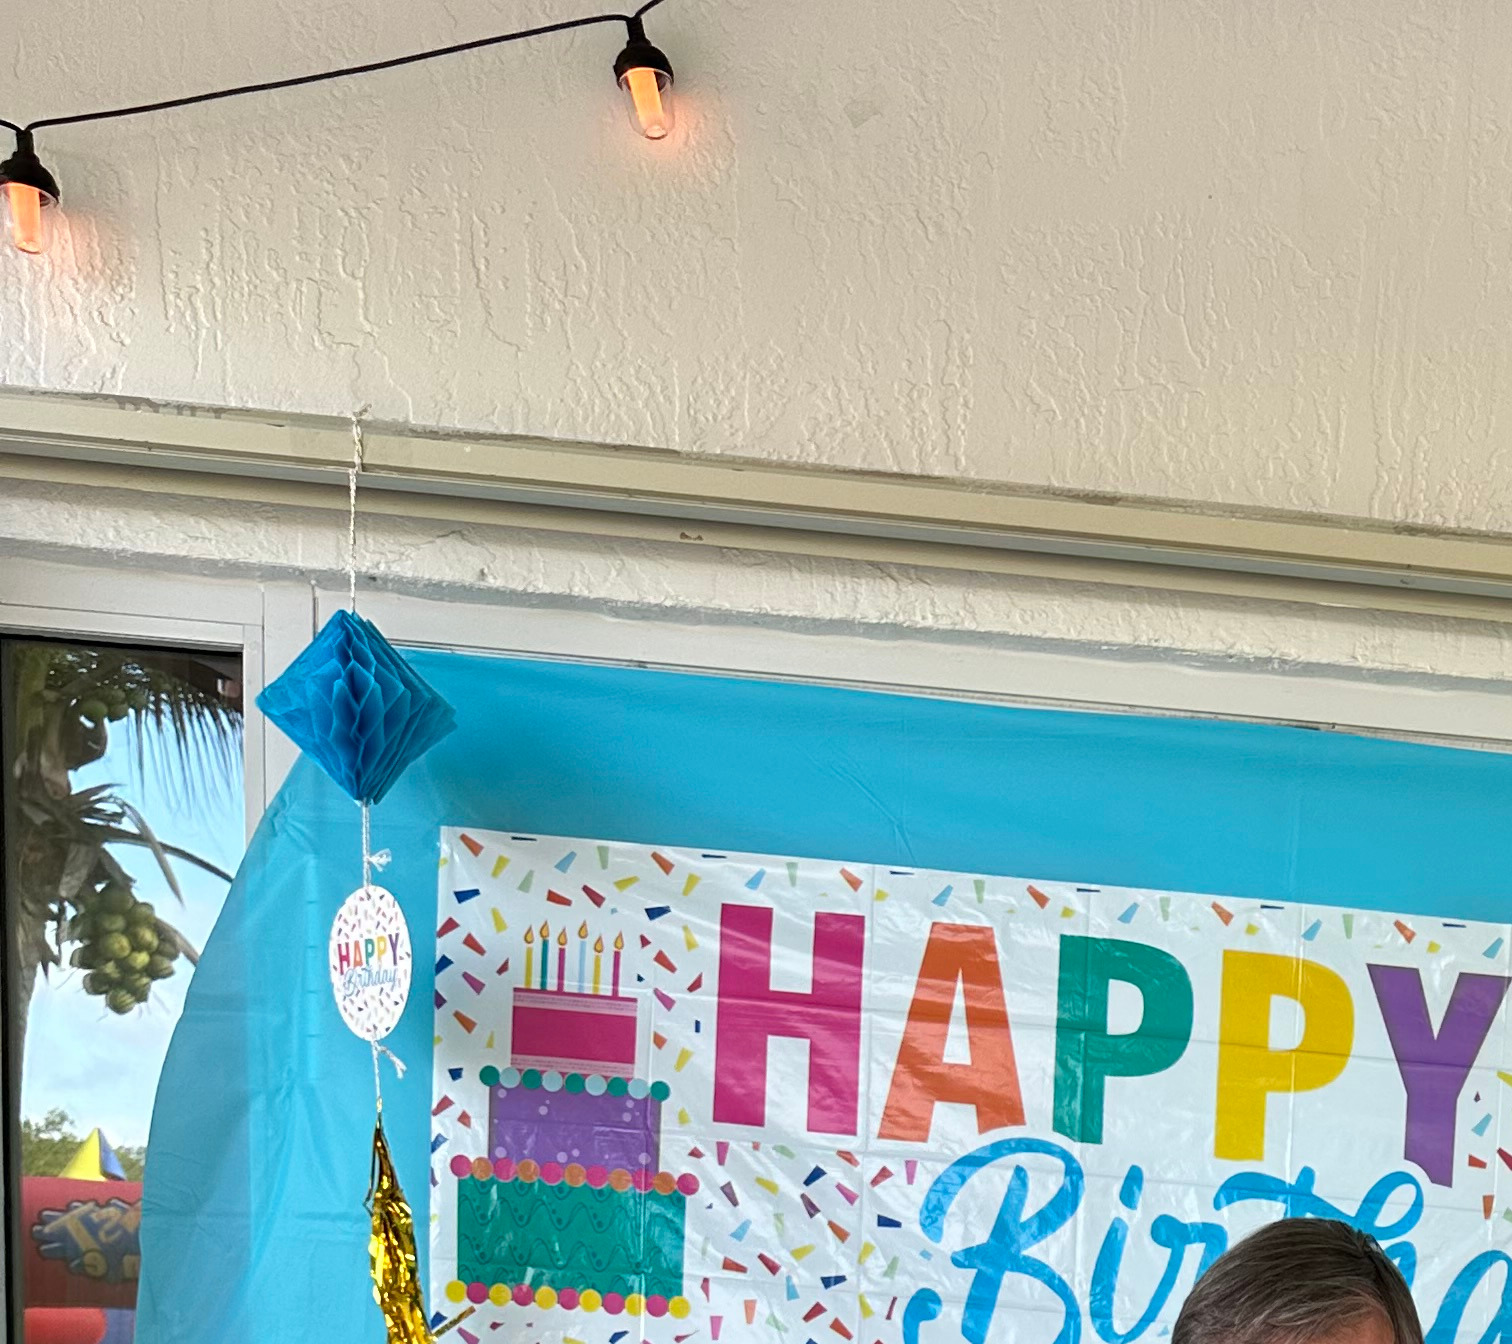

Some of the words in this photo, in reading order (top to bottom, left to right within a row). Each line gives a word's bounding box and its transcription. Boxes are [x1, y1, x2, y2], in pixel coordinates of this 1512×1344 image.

[337, 932, 400, 975] HAPPY
[343, 967, 398, 997] Birthday
[713, 903, 1512, 1188] HAPPY
